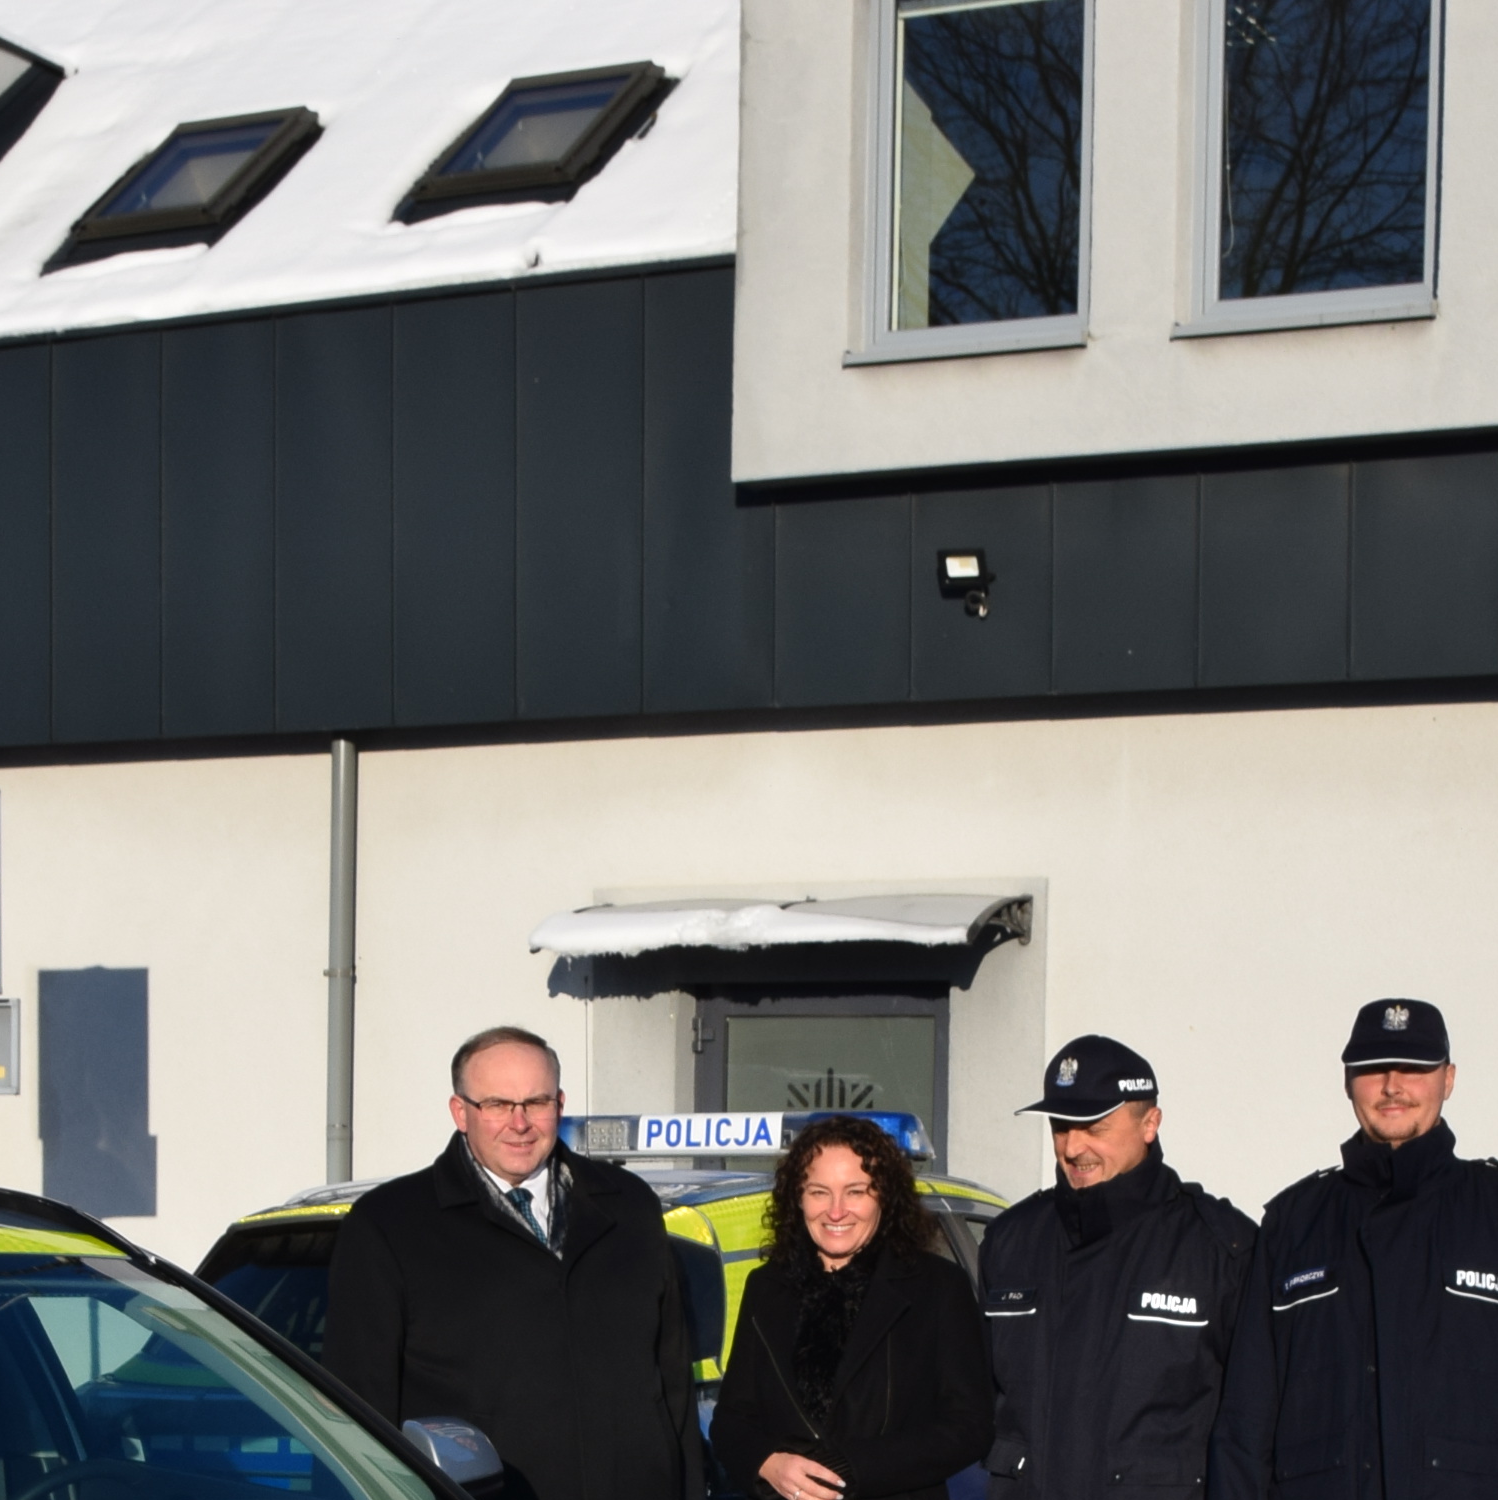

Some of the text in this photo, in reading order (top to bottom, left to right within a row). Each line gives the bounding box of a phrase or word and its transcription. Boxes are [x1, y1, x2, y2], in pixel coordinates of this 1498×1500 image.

[1118, 1078, 1154, 1091] POLICJA
[646, 1117, 773, 1148] POLICJA
[1141, 1292, 1197, 1314] POLICJA
